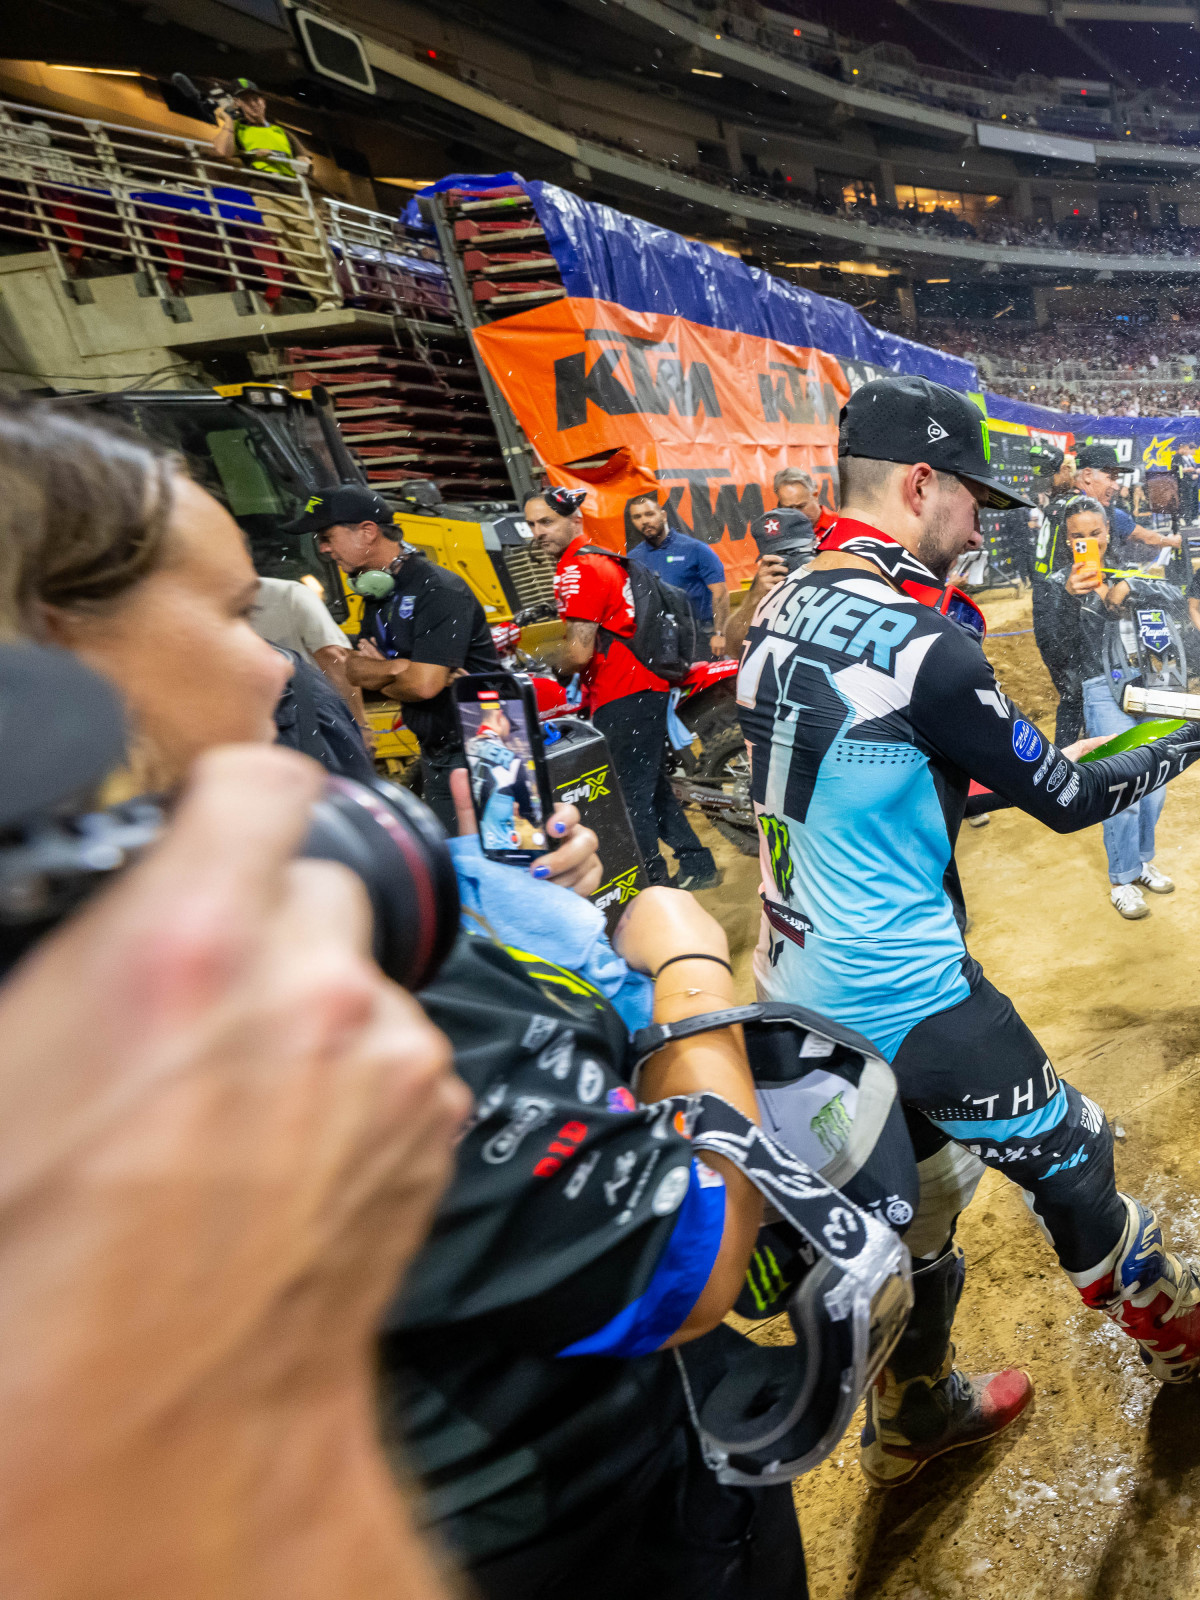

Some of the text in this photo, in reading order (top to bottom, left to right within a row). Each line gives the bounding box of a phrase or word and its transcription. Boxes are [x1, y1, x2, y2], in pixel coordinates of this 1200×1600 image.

[554, 329, 722, 432] KTM
[758, 362, 839, 426] KTM
[561, 771, 610, 804] SMX
[595, 872, 640, 911] SMX
